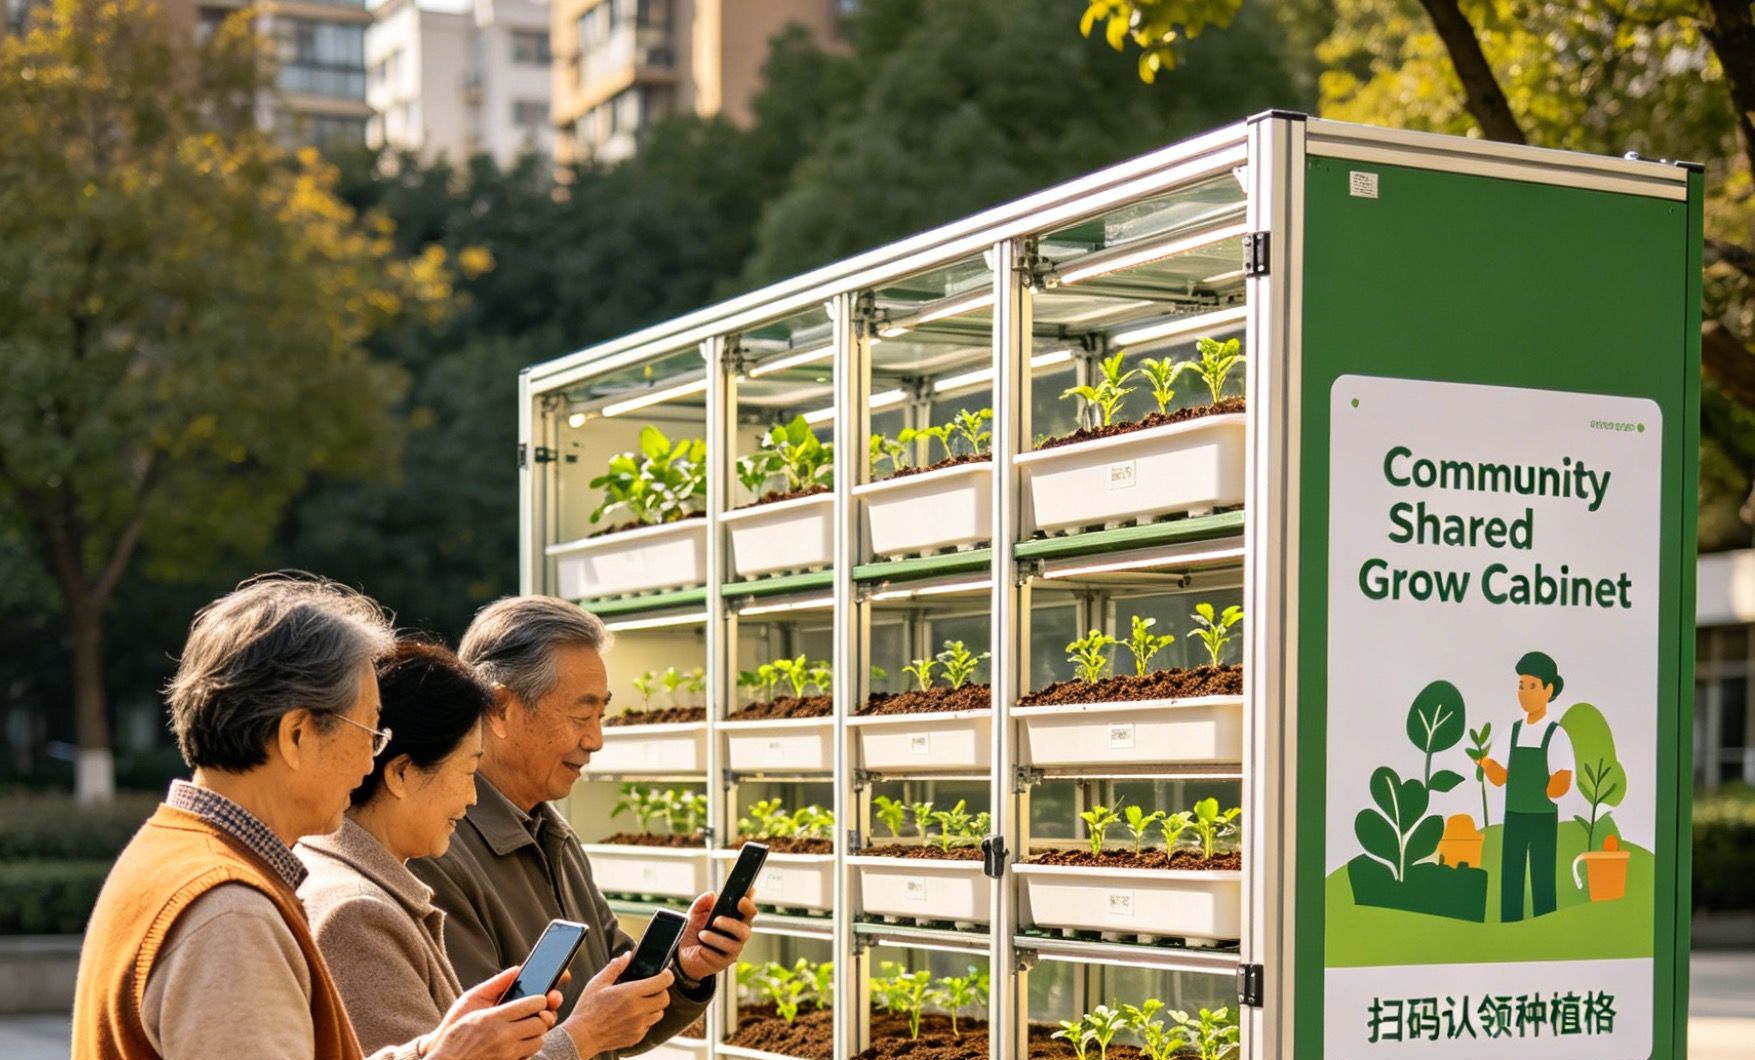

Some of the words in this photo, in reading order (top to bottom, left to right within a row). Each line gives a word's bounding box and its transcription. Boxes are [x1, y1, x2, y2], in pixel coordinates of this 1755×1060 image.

[1383, 445, 1612, 512] Community
[1388, 501, 1534, 550] Shared
[1358, 558, 1471, 604] Grow
[1481, 562, 1633, 609] Cabinet
[1367, 990, 1617, 1044] 扫码认领种植格
